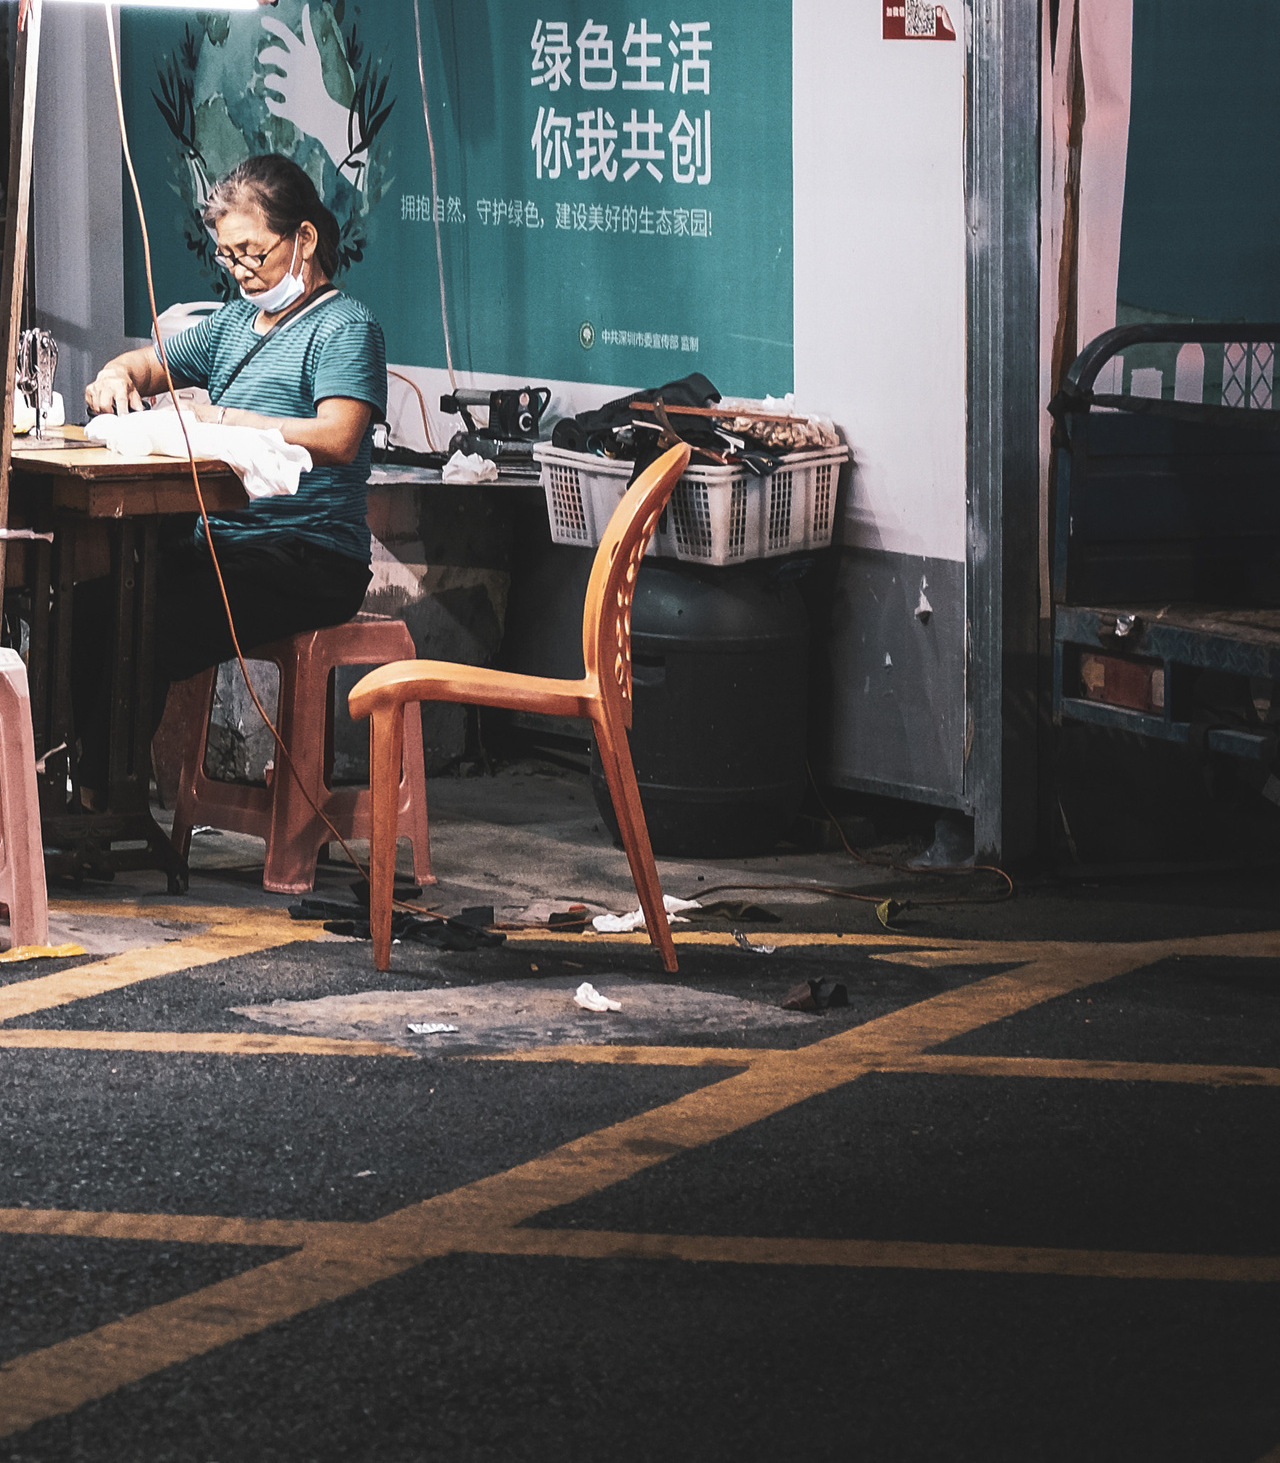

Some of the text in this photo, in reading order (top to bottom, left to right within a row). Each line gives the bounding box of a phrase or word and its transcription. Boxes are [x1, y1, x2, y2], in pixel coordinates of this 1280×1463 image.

[530, 18, 712, 95] 绿色生活
[531, 106, 712, 185] 你我共创
